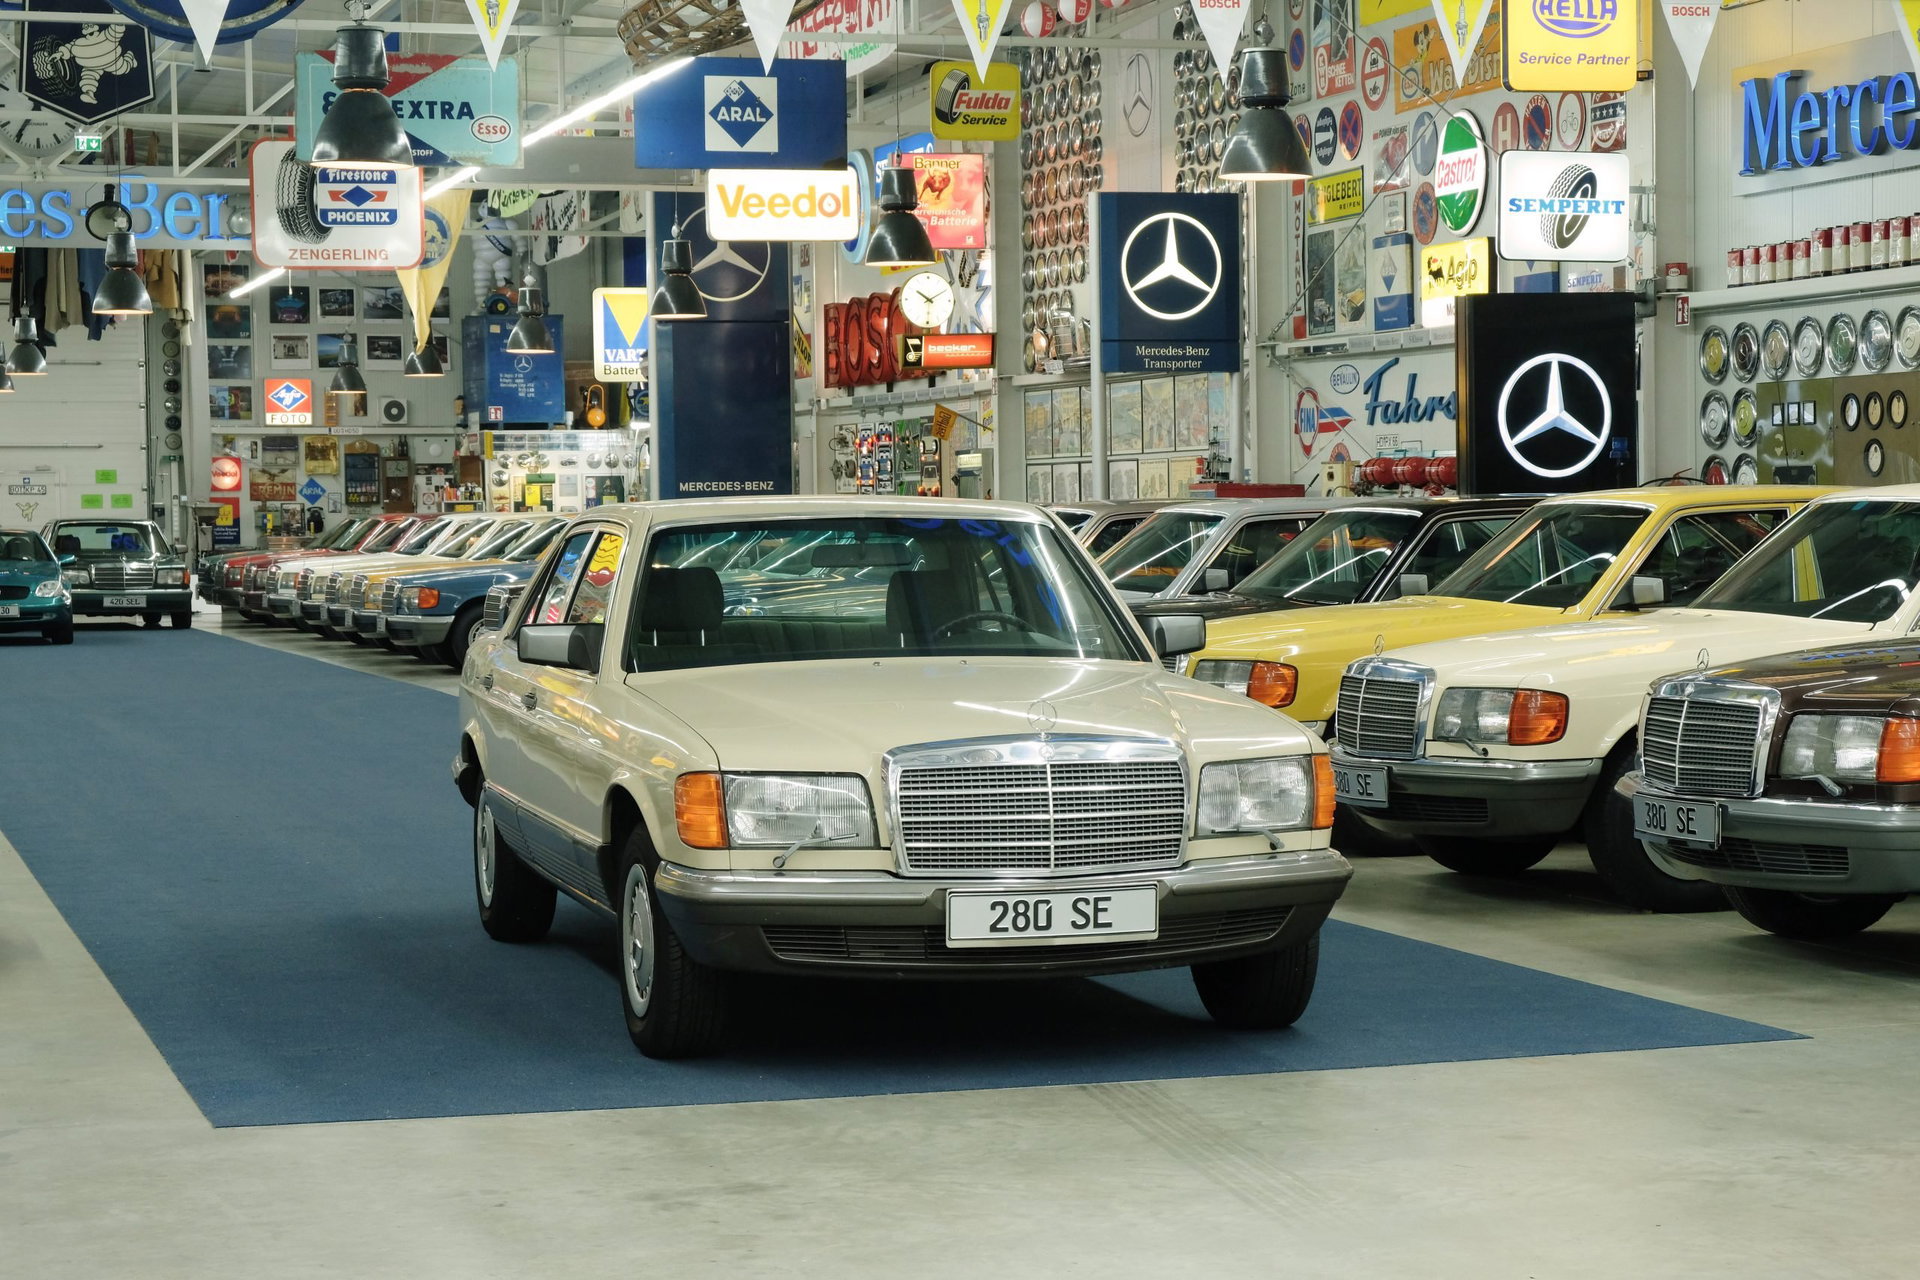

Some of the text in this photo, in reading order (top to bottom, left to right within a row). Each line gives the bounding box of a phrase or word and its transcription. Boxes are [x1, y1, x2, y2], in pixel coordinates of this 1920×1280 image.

[1200, 0, 1240, 9] BOSCH
[1671, 6, 1711, 17] BOSCH
[1519, 52, 1630, 66] Service Partner
[1328, 62, 1346, 79] SCHNEE
[1290, 82, 1306, 97] Zone
[954, 92, 1012, 111] Fulda
[397, 100, 475, 120] EXTRA
[717, 106, 766, 122] ARAL
[961, 114, 1008, 126] Service
[1738, 70, 1920, 176] Merce
[411, 149, 434, 157] STOFF
[914, 157, 961, 169] Banner
[326, 169, 389, 182] Firestone
[1438, 154, 1478, 189] Castrol
[717, 184, 851, 218] Veedol
[1339, 201, 1361, 211] REIFEN
[1509, 197, 1625, 214] SEMPERIT
[327, 211, 390, 223] PHOENIX
[930, 215, 978, 226] Batterie
[288, 248, 389, 260] ZENGERLING
[1294, 199, 1302, 312] MOTANOL
[1446, 252, 1478, 290] Agip
[928, 343, 976, 351] becker
[1136, 345, 1210, 356] Mercedes-Benz
[604, 365, 641, 376] Batter
[1143, 358, 1203, 370] Transporter
[1363, 357, 1457, 425] Fahrs
[270, 413, 307, 424] FOTO
[1299, 407, 1316, 433] FINA
[679, 481, 774, 492] MERCEDES-BENZ
[0, 606, 10, 615] 30
[1357, 773, 1374, 797] SE
[1645, 802, 1697, 835] 380 SE
[989, 895, 1113, 933] 280 SE
